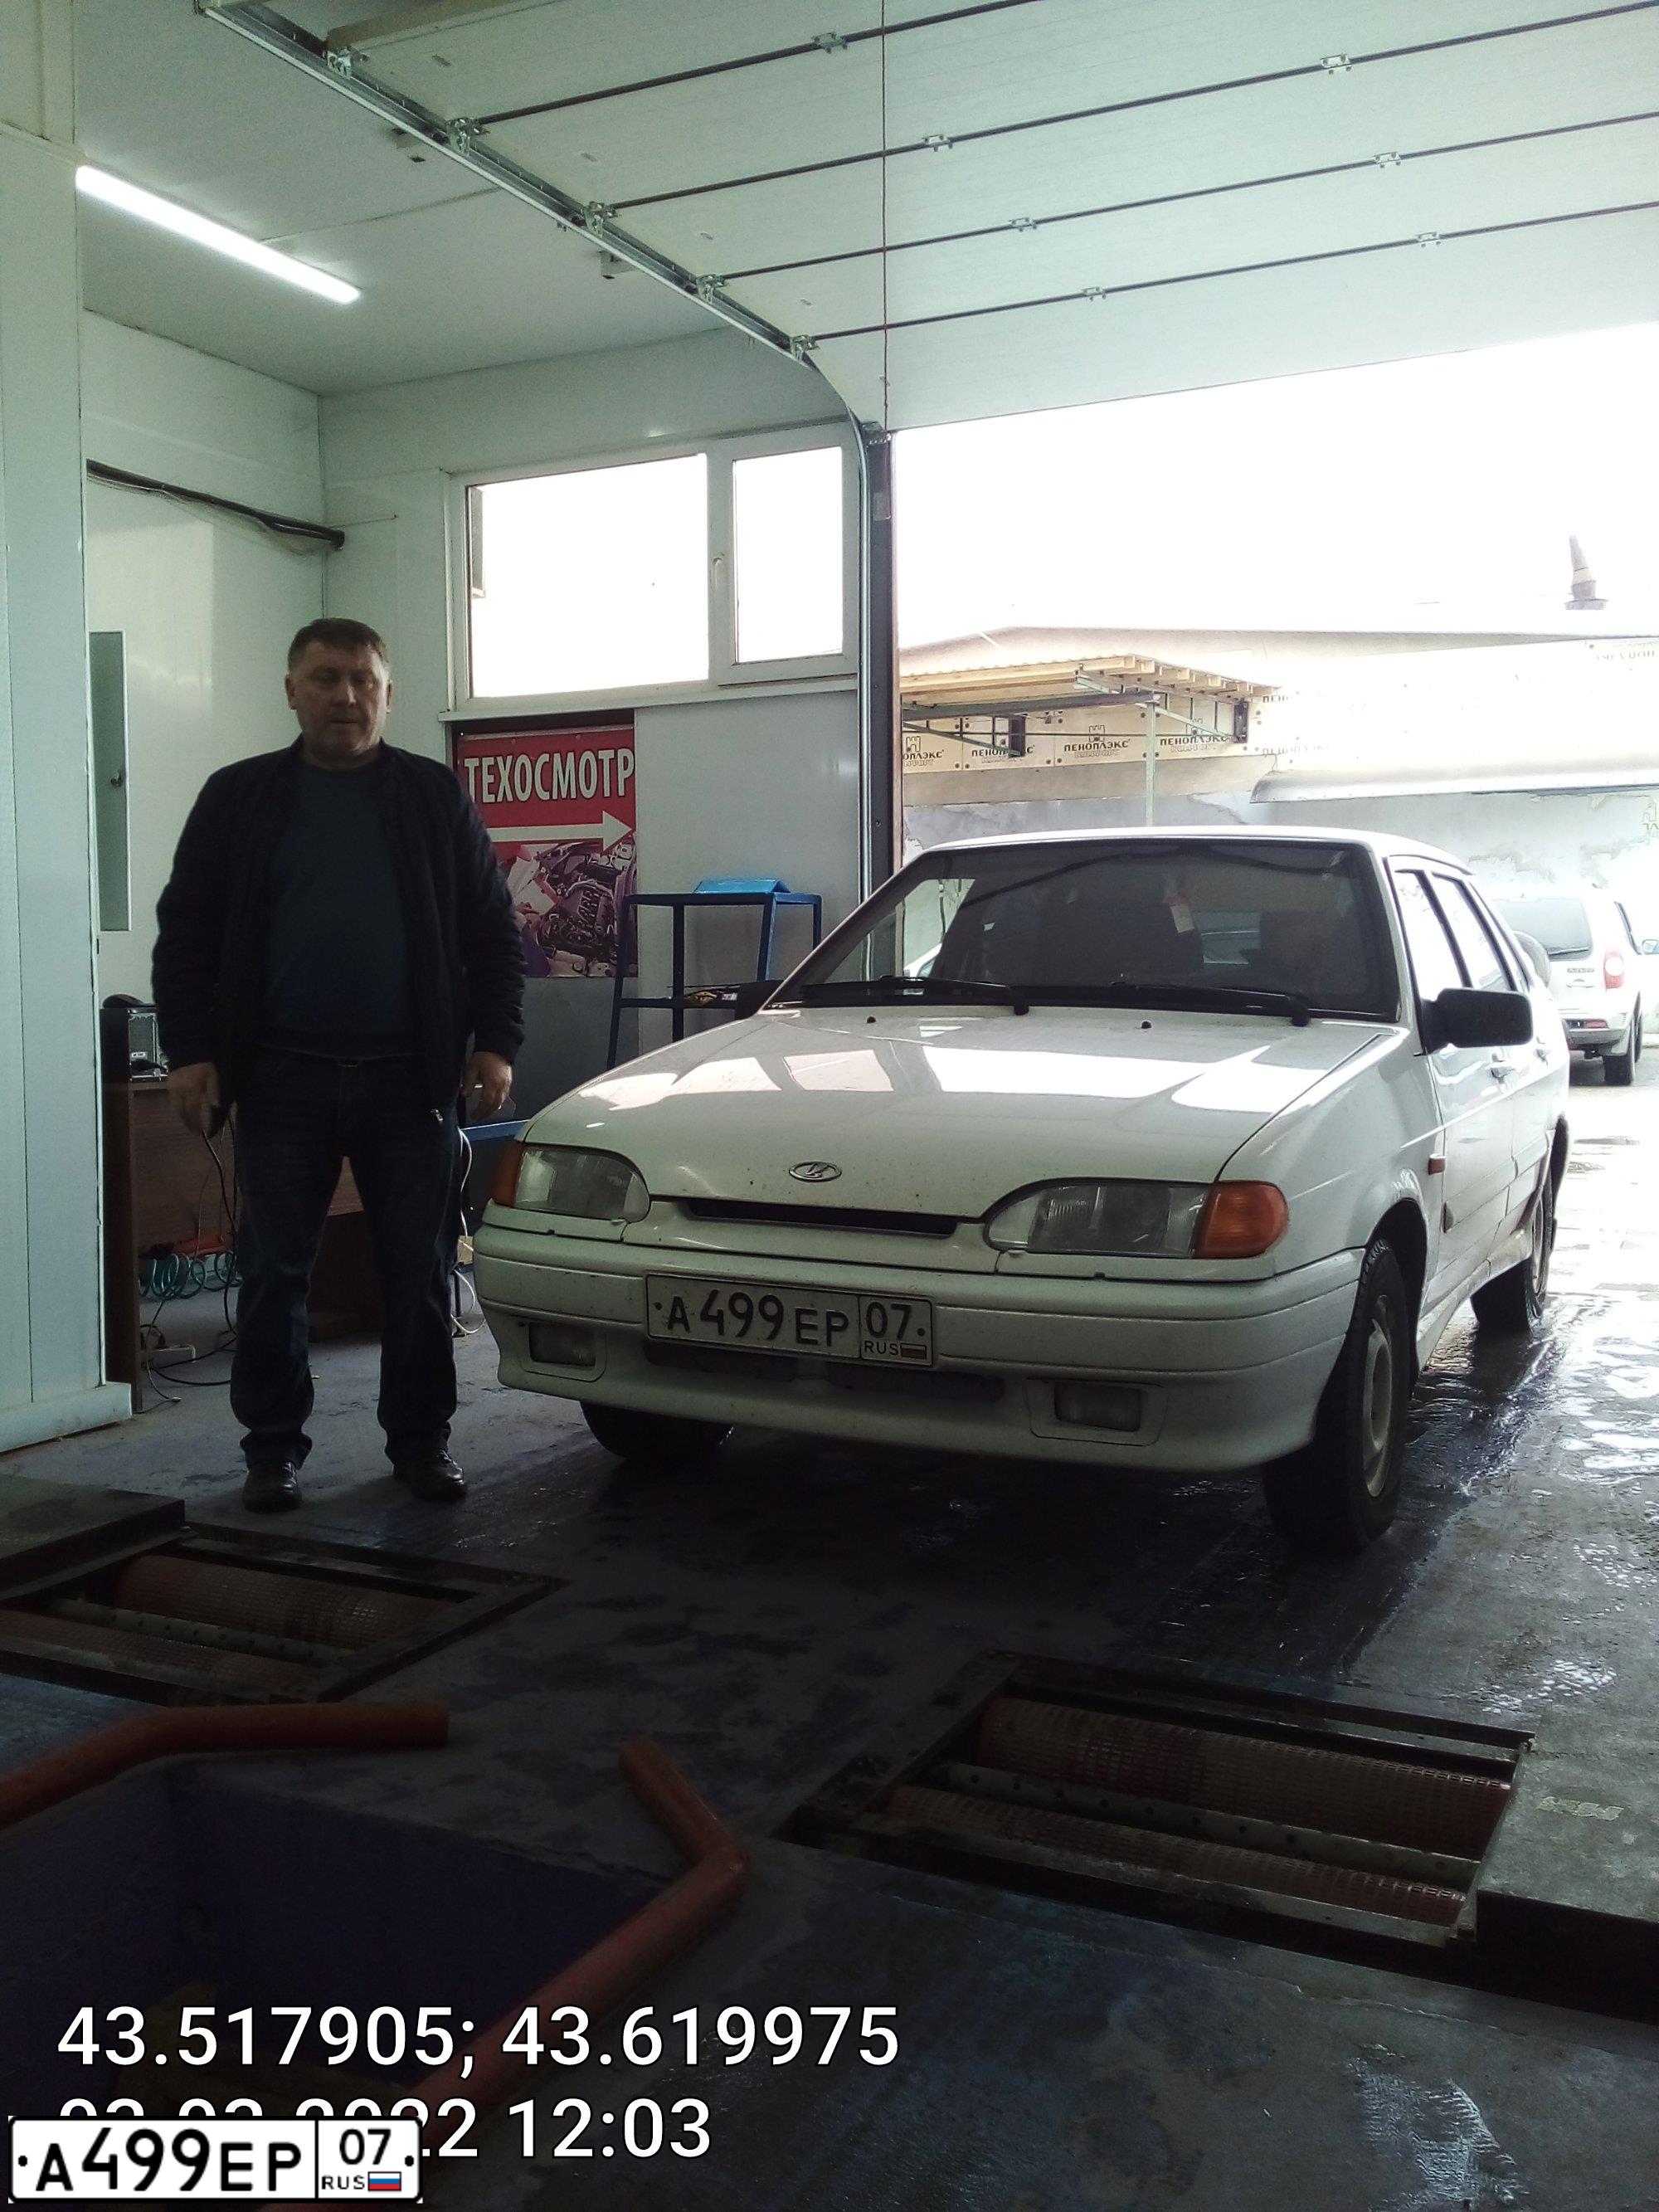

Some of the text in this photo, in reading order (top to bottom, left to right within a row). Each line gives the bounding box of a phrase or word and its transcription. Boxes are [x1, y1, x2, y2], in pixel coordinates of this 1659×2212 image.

[1064, 739, 1131, 752] ПЕНОПЛЭКС
[464, 748, 635, 803] ТЕХОСМОТР
[667, 1289, 912, 1347] А499ЕР 07
[864, 1341, 899, 1356] RUS
